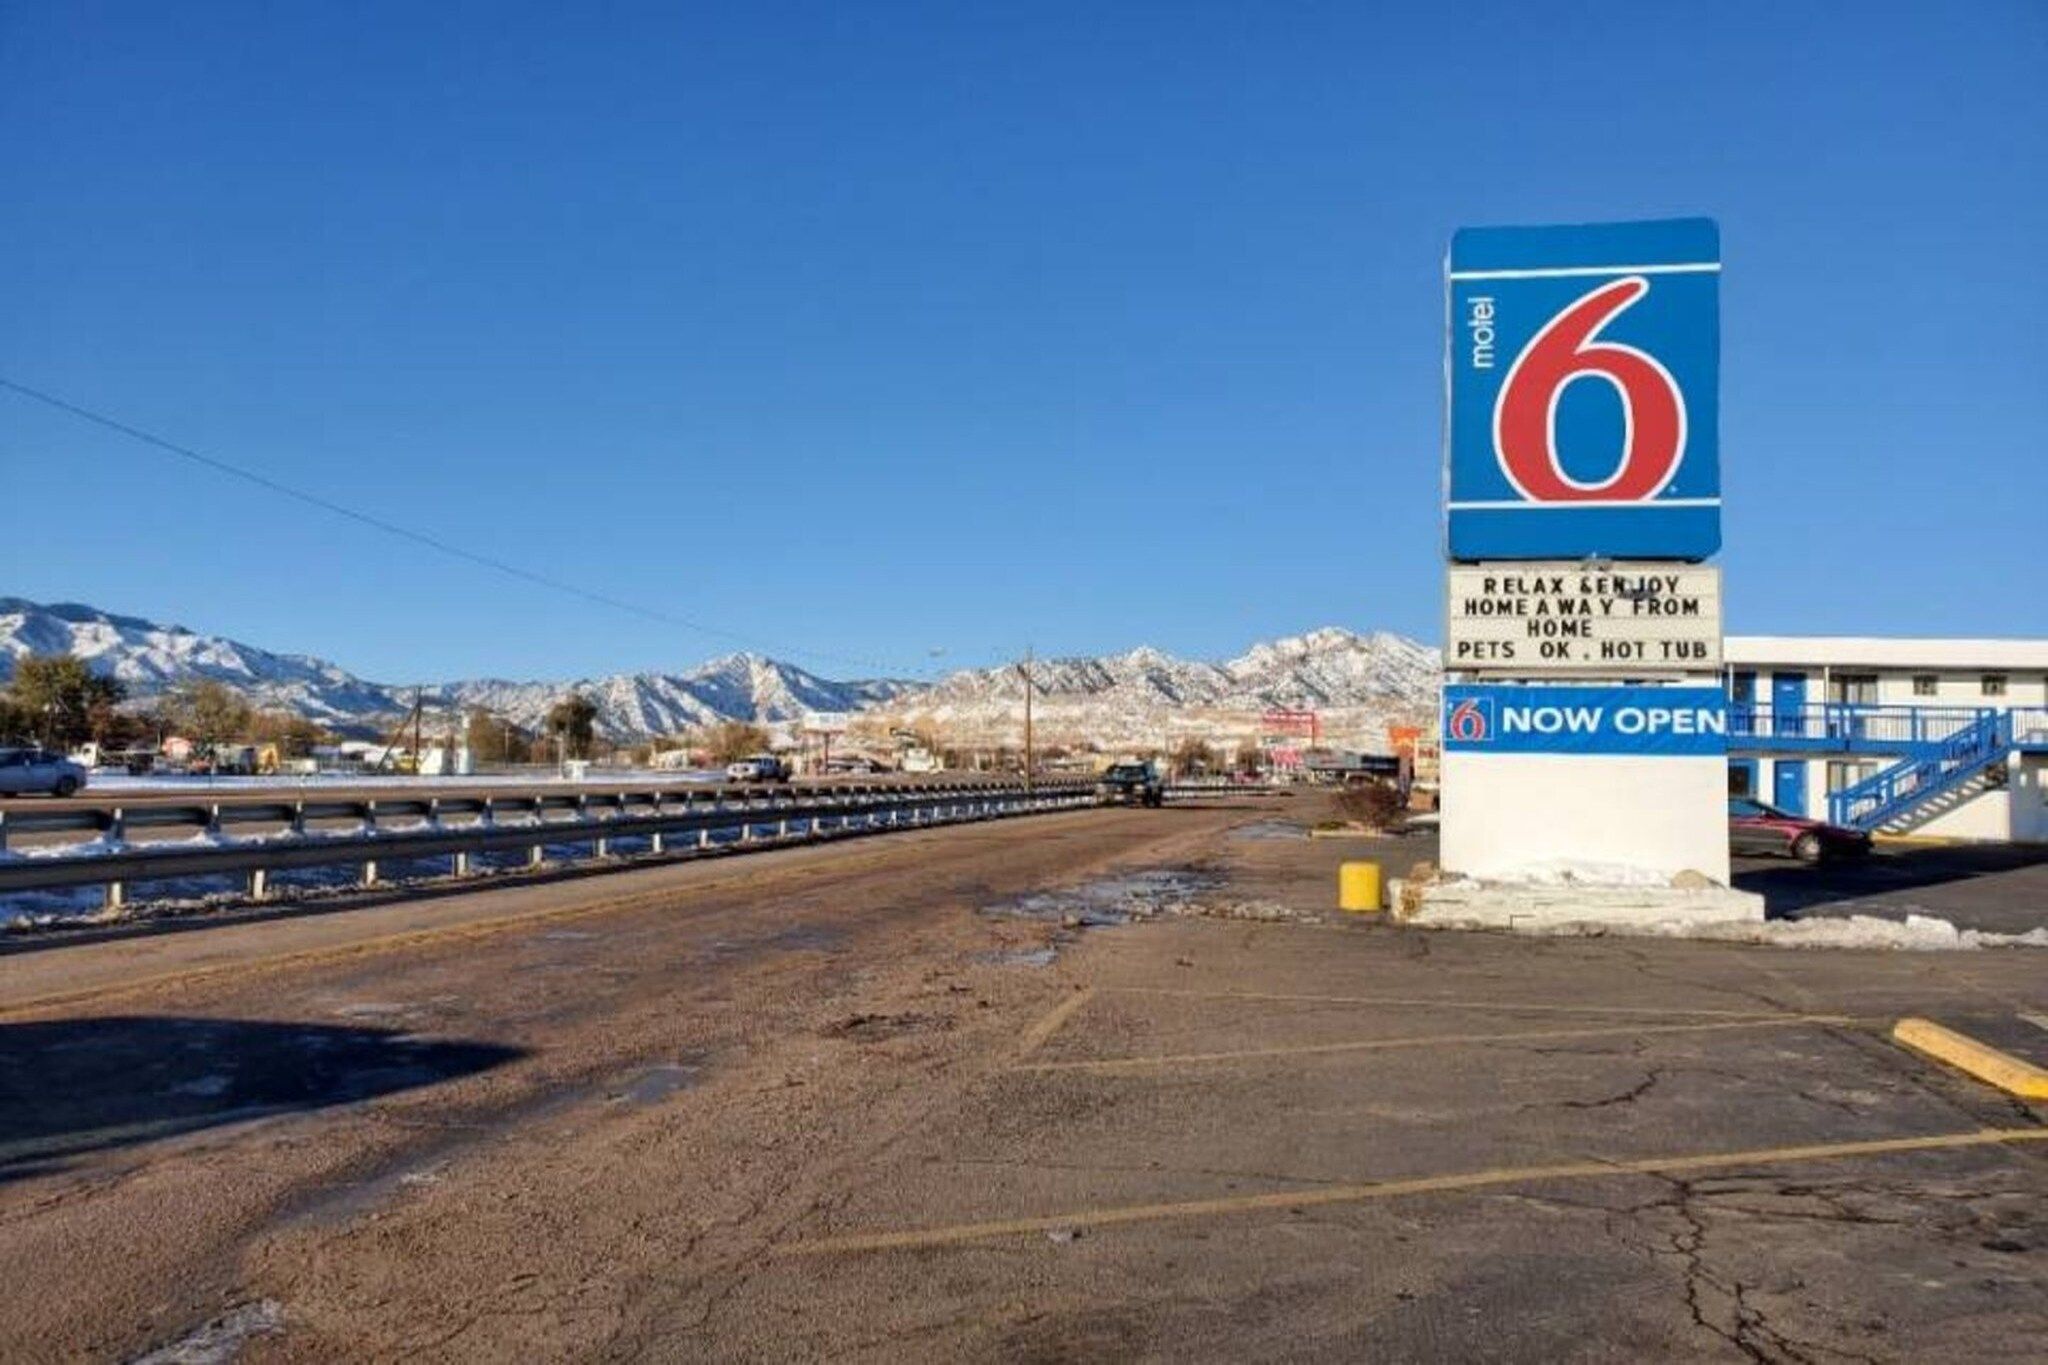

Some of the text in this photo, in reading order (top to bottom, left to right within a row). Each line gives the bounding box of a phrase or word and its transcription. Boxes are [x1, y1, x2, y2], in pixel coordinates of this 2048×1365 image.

[1467, 297, 1495, 369] motel
[1492, 275, 1688, 503] 6
[1484, 577, 1564, 594] RELAX
[1633, 599, 1699, 616] FROM
[1527, 620, 1594, 638] HOME
[1458, 641, 1515, 659] PETS
[1601, 641, 1644, 659] HOT
[1660, 641, 1708, 659] TUB
[1503, 707, 1604, 734] NOW
[1614, 707, 1726, 734] OPEN
